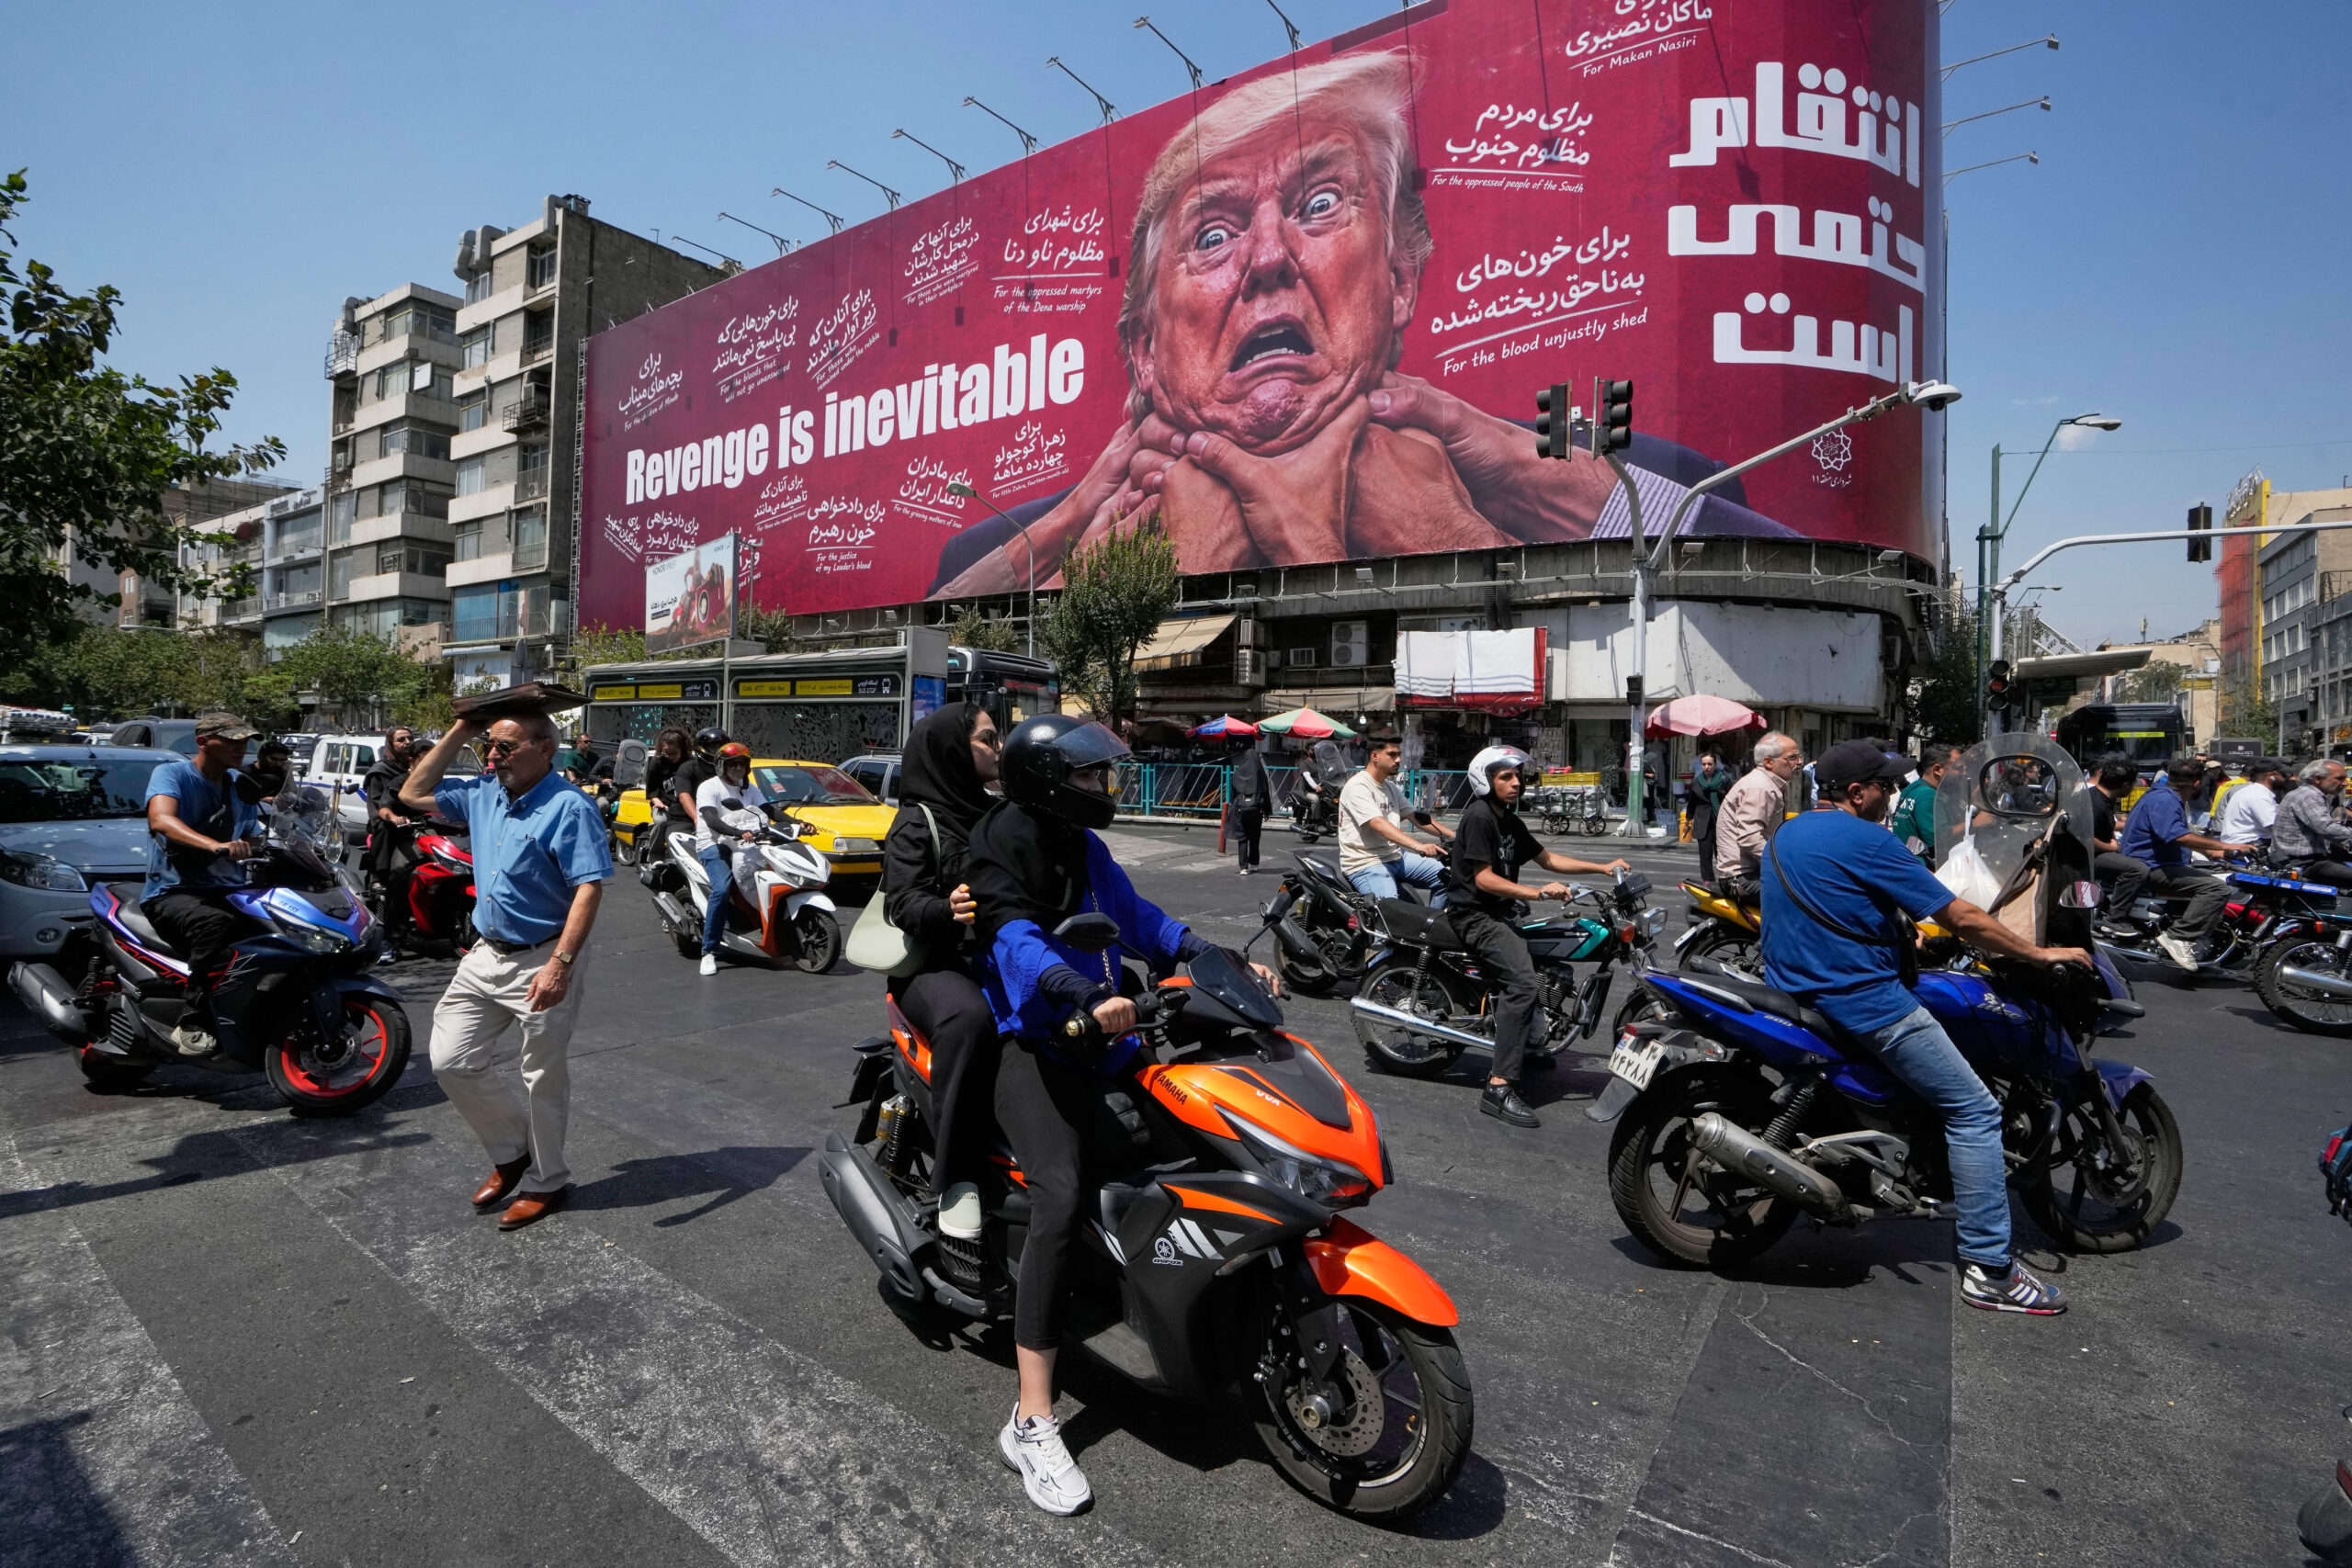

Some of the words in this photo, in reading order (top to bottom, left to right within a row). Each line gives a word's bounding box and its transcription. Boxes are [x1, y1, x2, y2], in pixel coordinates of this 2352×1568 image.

[1654, 0, 1713, 32] ماکان
[1565, 13, 1651, 57] نصیری
[1583, 63, 1604, 78] For
[1610, 50, 1653, 69] Makan
[1658, 35, 1697, 54] Nasiri
[1475, 104, 1537, 133] مردم
[1538, 101, 1593, 136] برای
[1668, 61, 1920, 188] انتقام
[1445, 133, 1520, 165] جنوب
[1517, 137, 1590, 168] مظلوم
[1431, 174, 1447, 186] For
[1449, 175, 1463, 186] the
[1464, 176, 1506, 191] oppressed
[1504, 178, 1530, 191] people
[1532, 177, 1544, 189] of
[1544, 180, 1557, 191] the
[1558, 181, 1584, 194] South
[949, 217, 972, 238] برای
[1024, 205, 1071, 234] شهدای
[1072, 208, 1104, 235] برای
[911, 233, 927, 253] که
[928, 220, 949, 247] آنها
[1576, 225, 1631, 265] برای
[1668, 195, 1927, 297] حتمی
[904, 243, 944, 276] کارشان
[944, 239, 967, 259] محل
[1004, 238, 1025, 263] دنا
[1026, 238, 1053, 269] ناو
[1054, 240, 1104, 271] مظلوم
[911, 265, 938, 287] شدند
[941, 251, 967, 275] شهید
[907, 296, 916, 305] For
[918, 289, 931, 299] those
[933, 283, 942, 291] who
[956, 264, 978, 280] martyred
[939, 281, 963, 297] workplace
[994, 285, 1008, 299] For
[1012, 287, 1024, 297] the
[1028, 284, 1069, 299] oppressed
[1070, 284, 1102, 299] martyrs
[777, 295, 798, 321] برای
[852, 288, 871, 312] برای
[1003, 301, 1014, 313] of
[1017, 301, 1030, 311] the
[1034, 301, 1053, 312] Dena
[1057, 299, 1086, 314] warship
[824, 293, 851, 336] آنان
[862, 303, 876, 330] زیر
[718, 317, 737, 344] که
[809, 318, 824, 347] که
[842, 310, 859, 347] آوار
[1713, 292, 1914, 384] است
[841, 356, 854, 371] under
[864, 333, 880, 350] rubble
[1443, 357, 1467, 377] For
[1472, 351, 1496, 368] the
[1501, 333, 1540, 359] blood
[1544, 319, 1607, 349] unjustly
[1612, 307, 1648, 331] shed
[639, 353, 662, 379] برای
[806, 339, 839, 373] ماندند
[816, 372, 826, 384] For
[828, 356, 843, 372] those
[845, 345, 856, 357] who
[720, 385, 729, 396] For
[733, 378, 741, 387] the
[743, 367, 762, 382] bloods
[763, 358, 776, 371] that
[618, 385, 647, 415] میناب
[725, 391, 735, 403] will
[737, 387, 746, 397] not
[748, 383, 754, 395] go
[626, 423, 769, 505] Revenge
[777, 404, 814, 469] is
[823, 333, 1085, 458] inevitable
[1015, 420, 1042, 442] برای
[994, 437, 1037, 468] کوچولو
[1040, 428, 1066, 453] زهرا
[908, 456, 947, 479] مادران
[993, 464, 1023, 481] ماهه
[1026, 452, 1064, 471] چهارده
[761, 482, 772, 499] که
[771, 476, 788, 498] آنان
[787, 475, 804, 491] برای
[899, 479, 932, 502] ایران
[1830, 473, 1852, 488] شهرداری
[646, 510, 684, 530] دادخواهی
[807, 495, 863, 521] دادخواهی
[864, 500, 886, 523] برای
[893, 503, 901, 513] For
[910, 511, 928, 523] grieving
[929, 515, 946, 525] mothers
[953, 521, 962, 529] Iran
[628, 516, 640, 534] برای
[684, 516, 699, 536] برای
[808, 525, 845, 545] رهبرم
[847, 523, 876, 546] خون
[668, 534, 696, 552] شهدای
[815, 563, 823, 573] of
[823, 565, 831, 574] my
[832, 562, 855, 571] Leader's
[856, 559, 872, 570] blood
[817, 552, 826, 562] For
[829, 552, 837, 560] the
[838, 551, 857, 562] justice
[1154, 1069, 1188, 1105] YAMAHA
